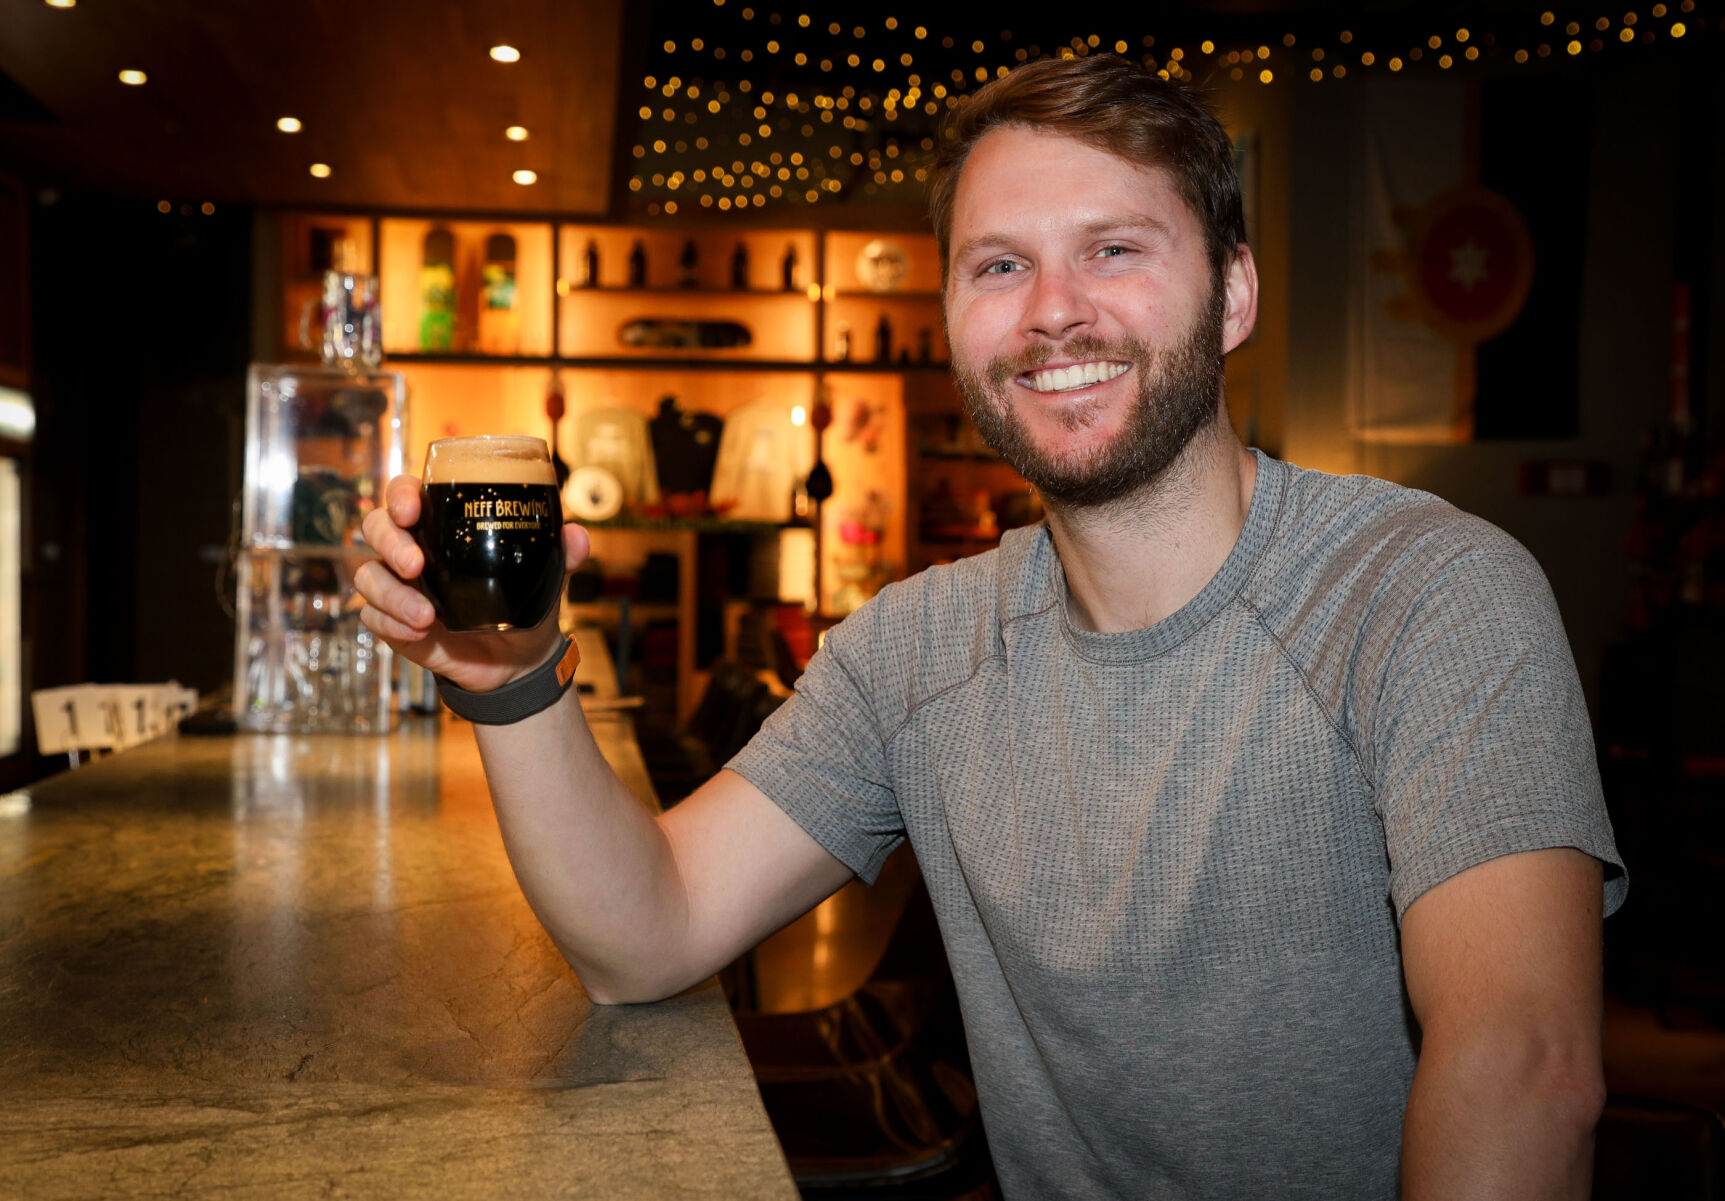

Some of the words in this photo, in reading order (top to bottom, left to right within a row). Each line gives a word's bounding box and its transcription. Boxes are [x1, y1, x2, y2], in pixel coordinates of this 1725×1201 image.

[464, 500, 494, 518] NEFF
[495, 499, 549, 517] BREWING
[476, 521, 502, 531] BREWED
[502, 521, 514, 530] FOR
